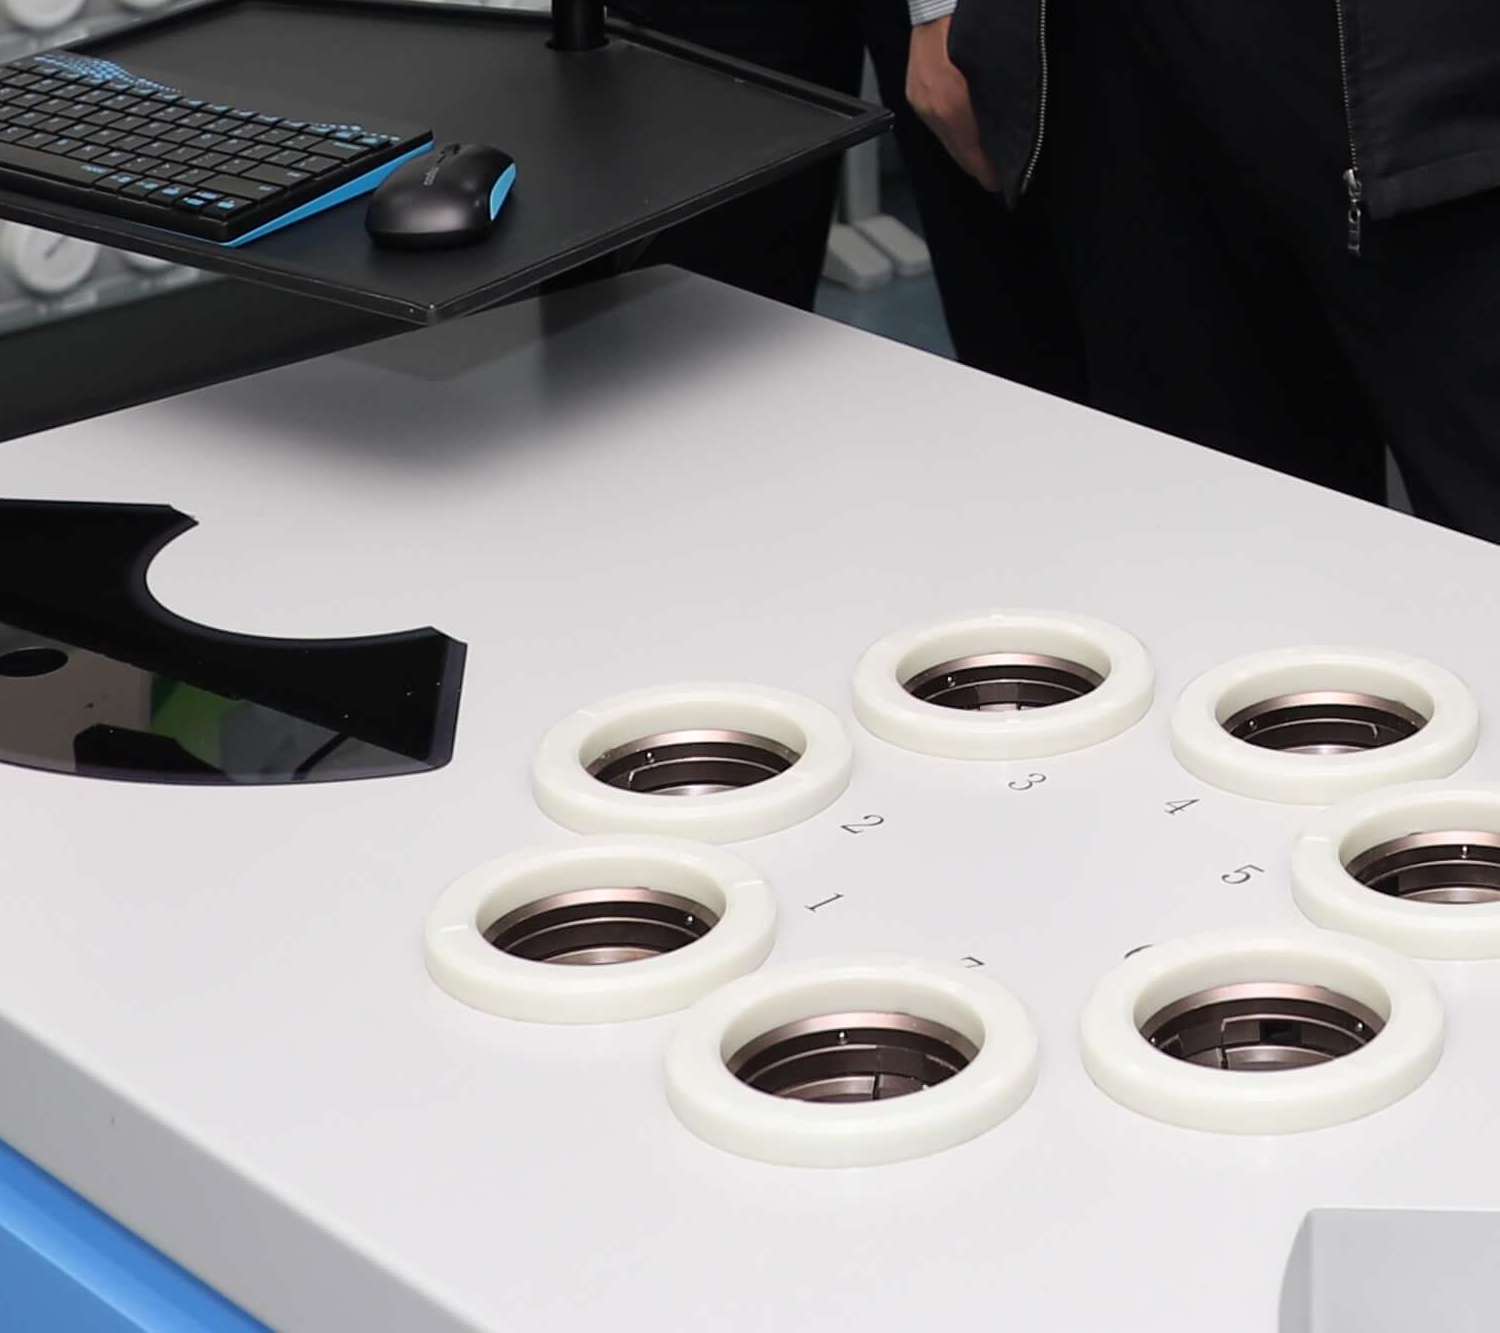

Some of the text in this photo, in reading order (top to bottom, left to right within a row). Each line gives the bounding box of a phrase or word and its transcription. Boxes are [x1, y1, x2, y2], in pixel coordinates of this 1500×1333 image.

[1007, 772, 1047, 791] 3
[1163, 797, 1200, 816] 4
[840, 813, 885, 834] 2
[1220, 863, 1265, 886] 5
[804, 892, 844, 913] 1
